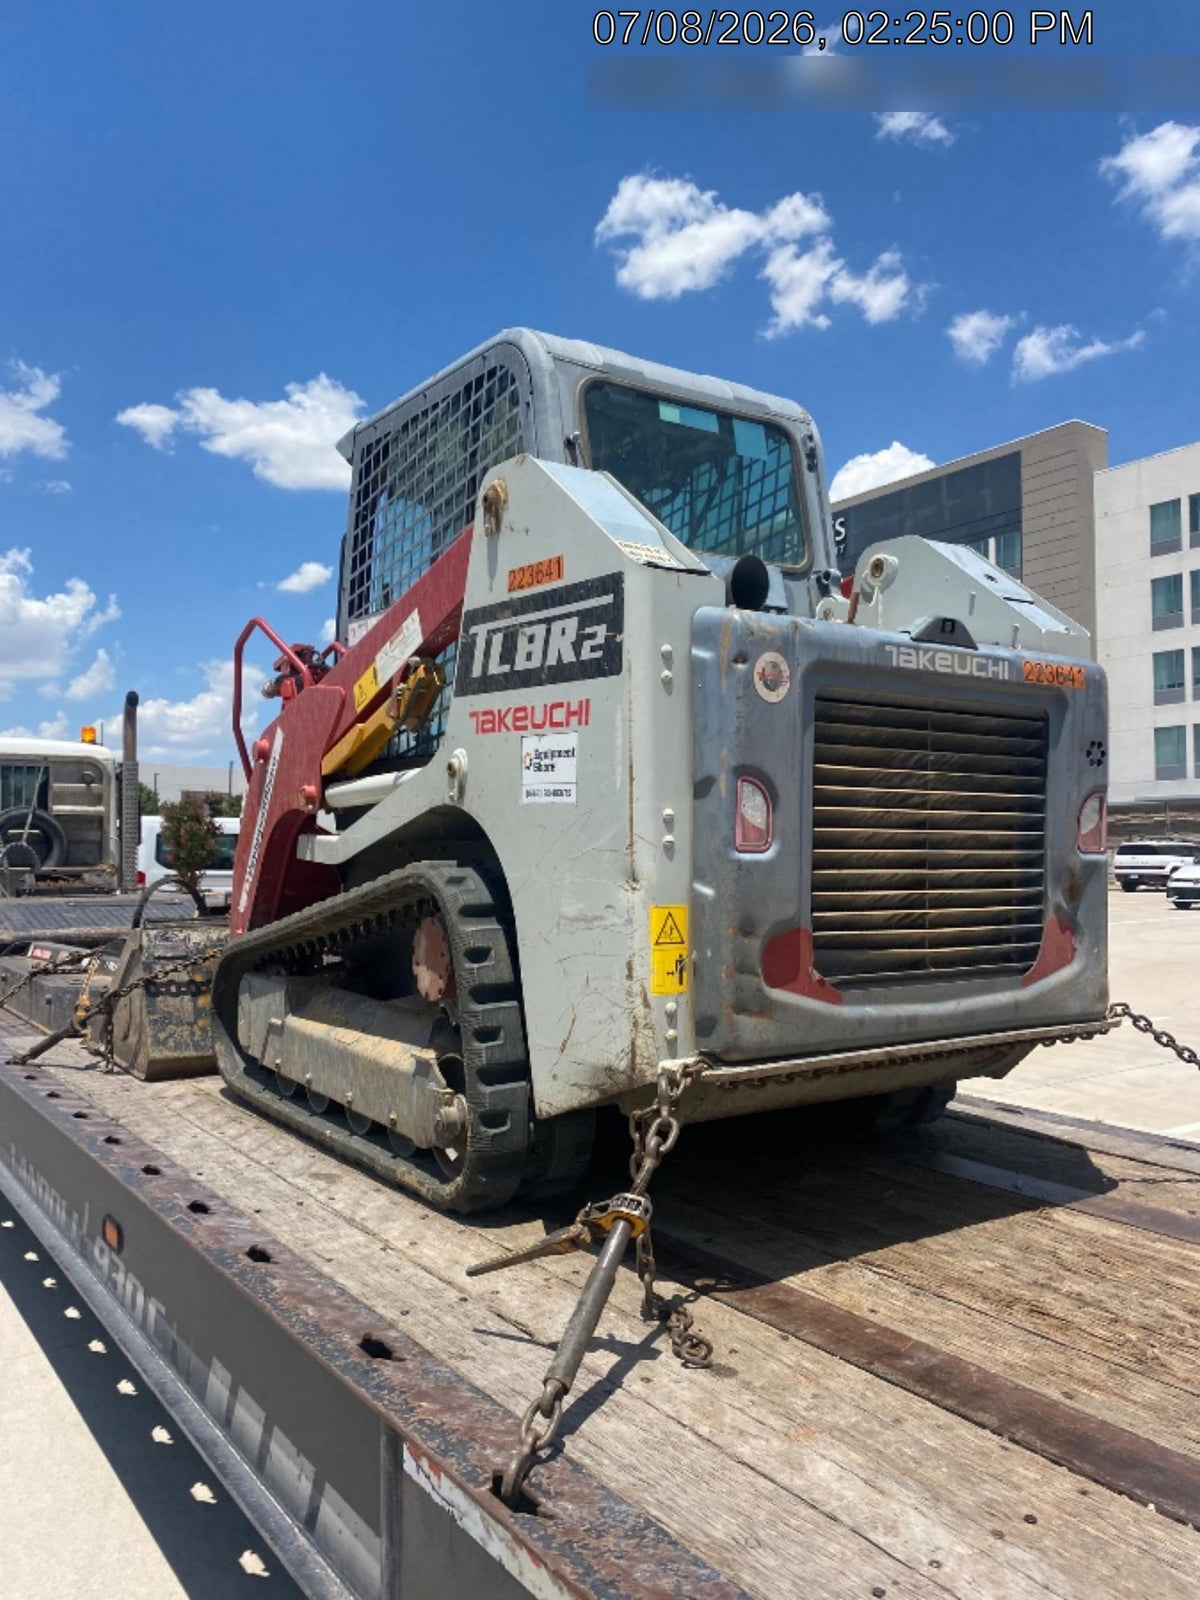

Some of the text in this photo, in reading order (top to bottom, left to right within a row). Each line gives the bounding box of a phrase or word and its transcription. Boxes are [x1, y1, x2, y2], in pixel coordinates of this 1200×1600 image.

[508, 555, 564, 592] 223641
[885, 645, 1010, 680] TAKEUCHI
[469, 698, 591, 734] TAKEUCHI
